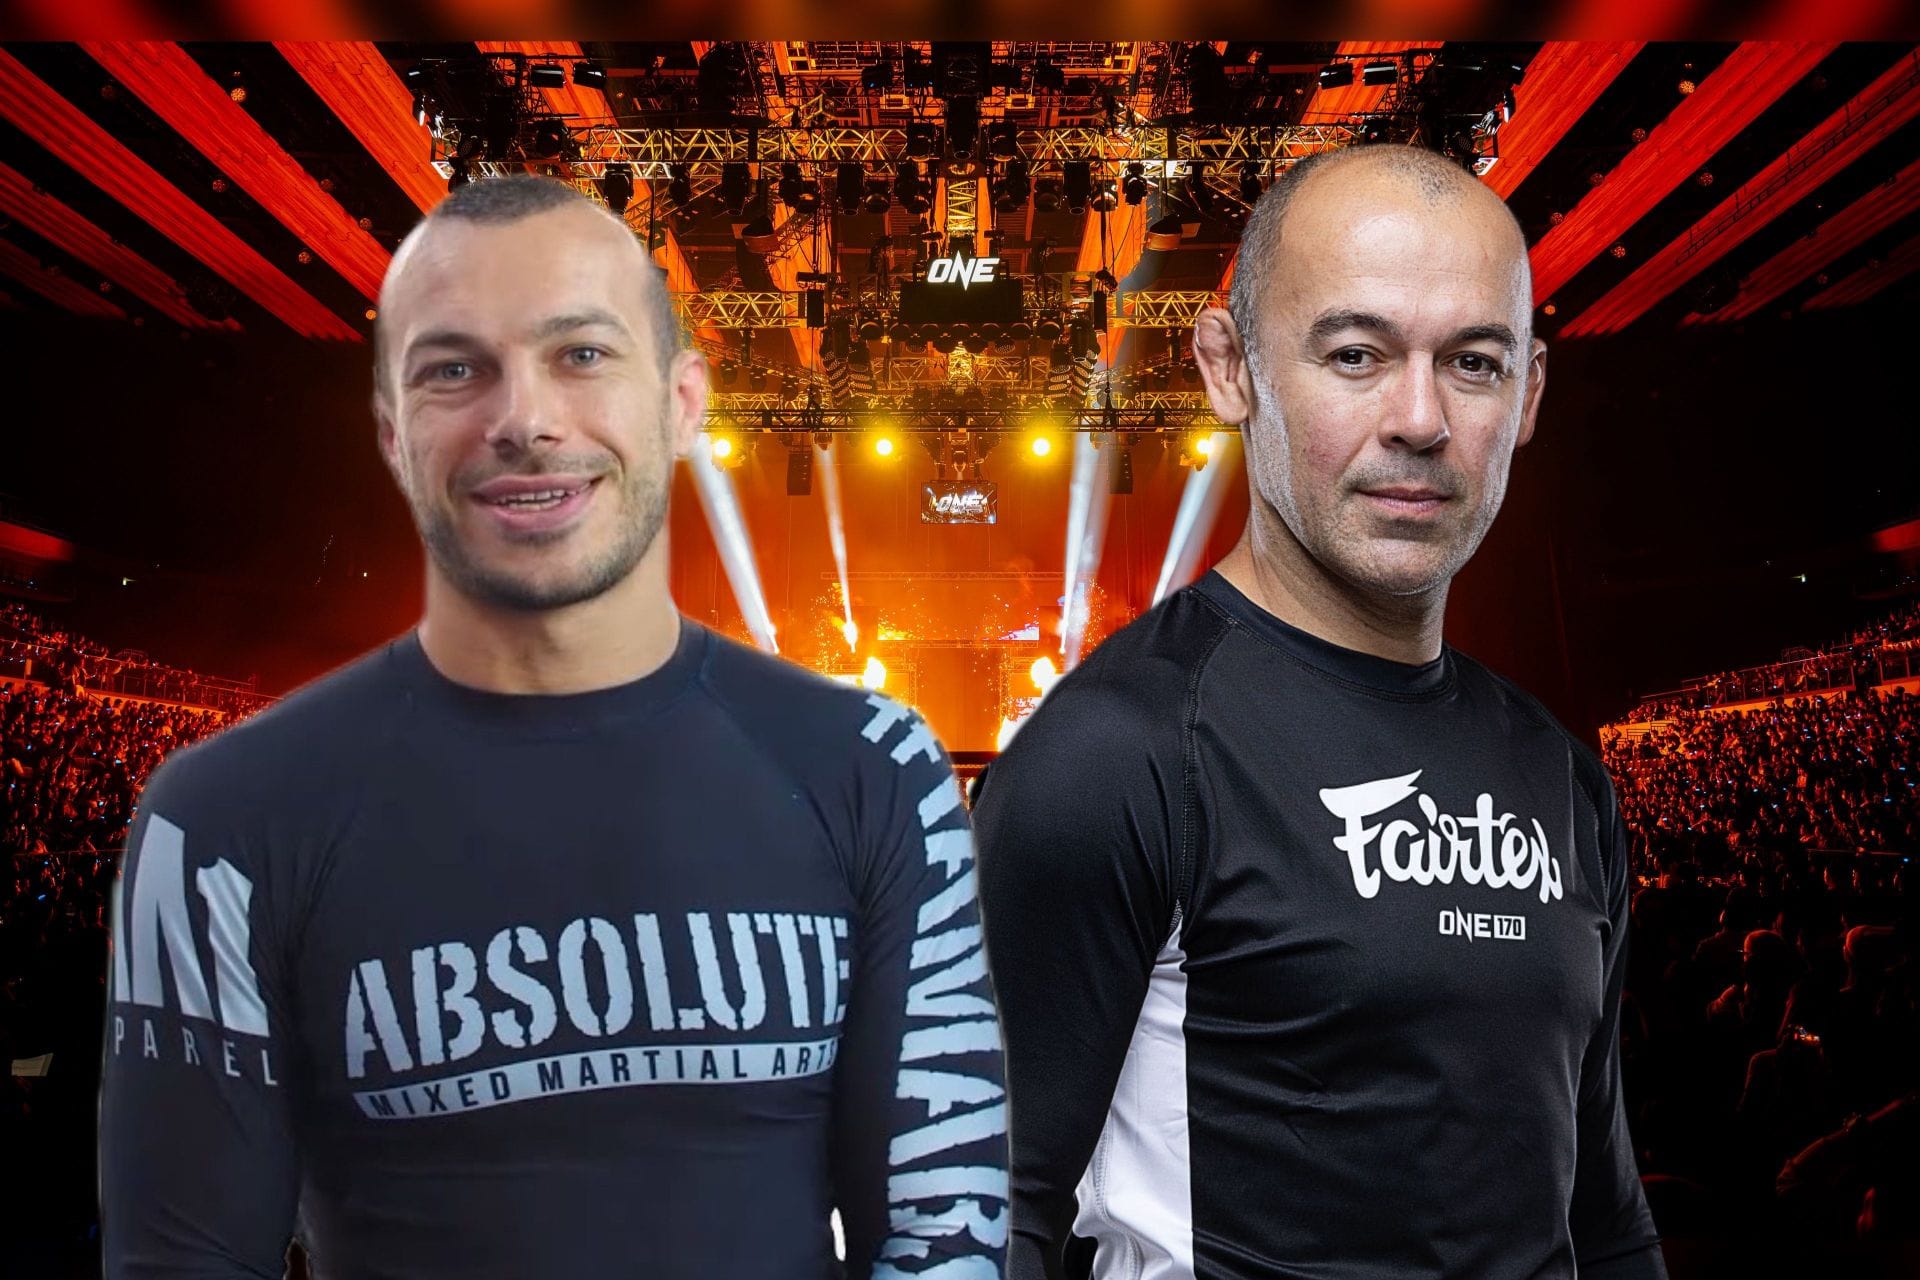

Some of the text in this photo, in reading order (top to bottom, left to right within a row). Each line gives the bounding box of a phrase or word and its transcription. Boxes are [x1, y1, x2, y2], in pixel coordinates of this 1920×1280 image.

[927, 250, 1000, 291] ONE
[935, 491, 984, 514] ONE
[1318, 768, 1564, 904] Fairtex
[1438, 905, 1523, 943] ONE 170
[345, 911, 850, 1079] ABSOLUTE
[367, 1070, 511, 1118] MIXED
[537, 1049, 748, 1093] MARTIAL
